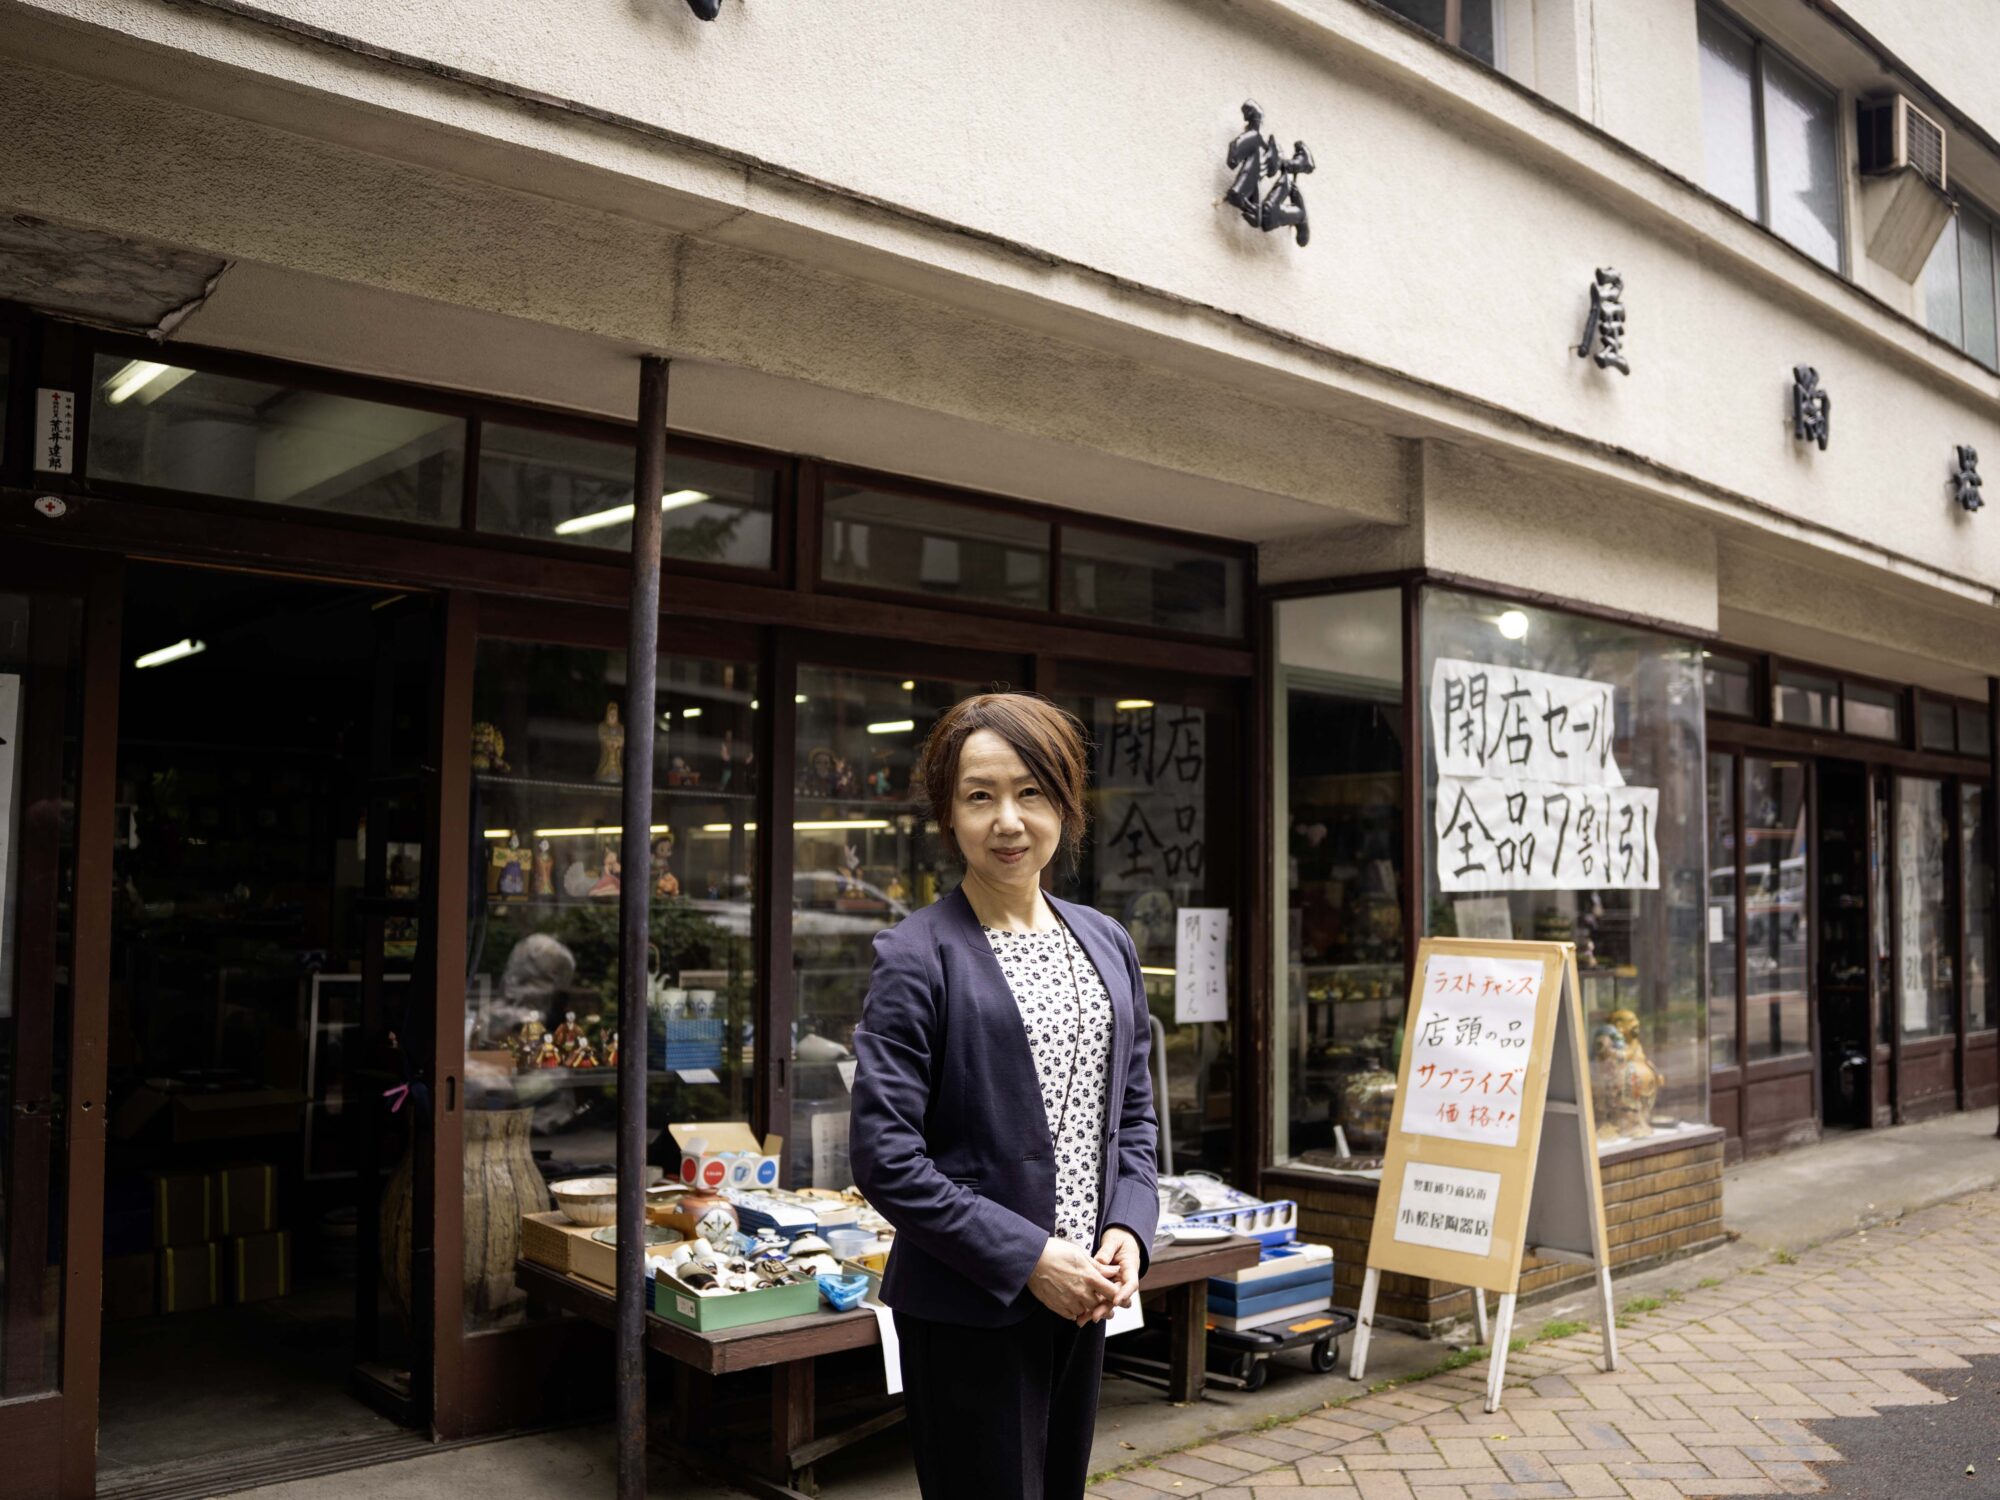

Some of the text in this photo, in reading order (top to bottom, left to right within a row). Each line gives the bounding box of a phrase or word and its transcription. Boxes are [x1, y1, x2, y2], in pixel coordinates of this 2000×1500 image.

[1444, 671, 1612, 769] 閉店セール
[1108, 801, 1204, 880] 全品
[1442, 786, 1649, 883] 全品7割引
[1417, 1013, 1526, 1049] 店頭の品
[1416, 1062, 1525, 1096] サプライズ
[1400, 1208, 1488, 1237] 小松屋陶器店
